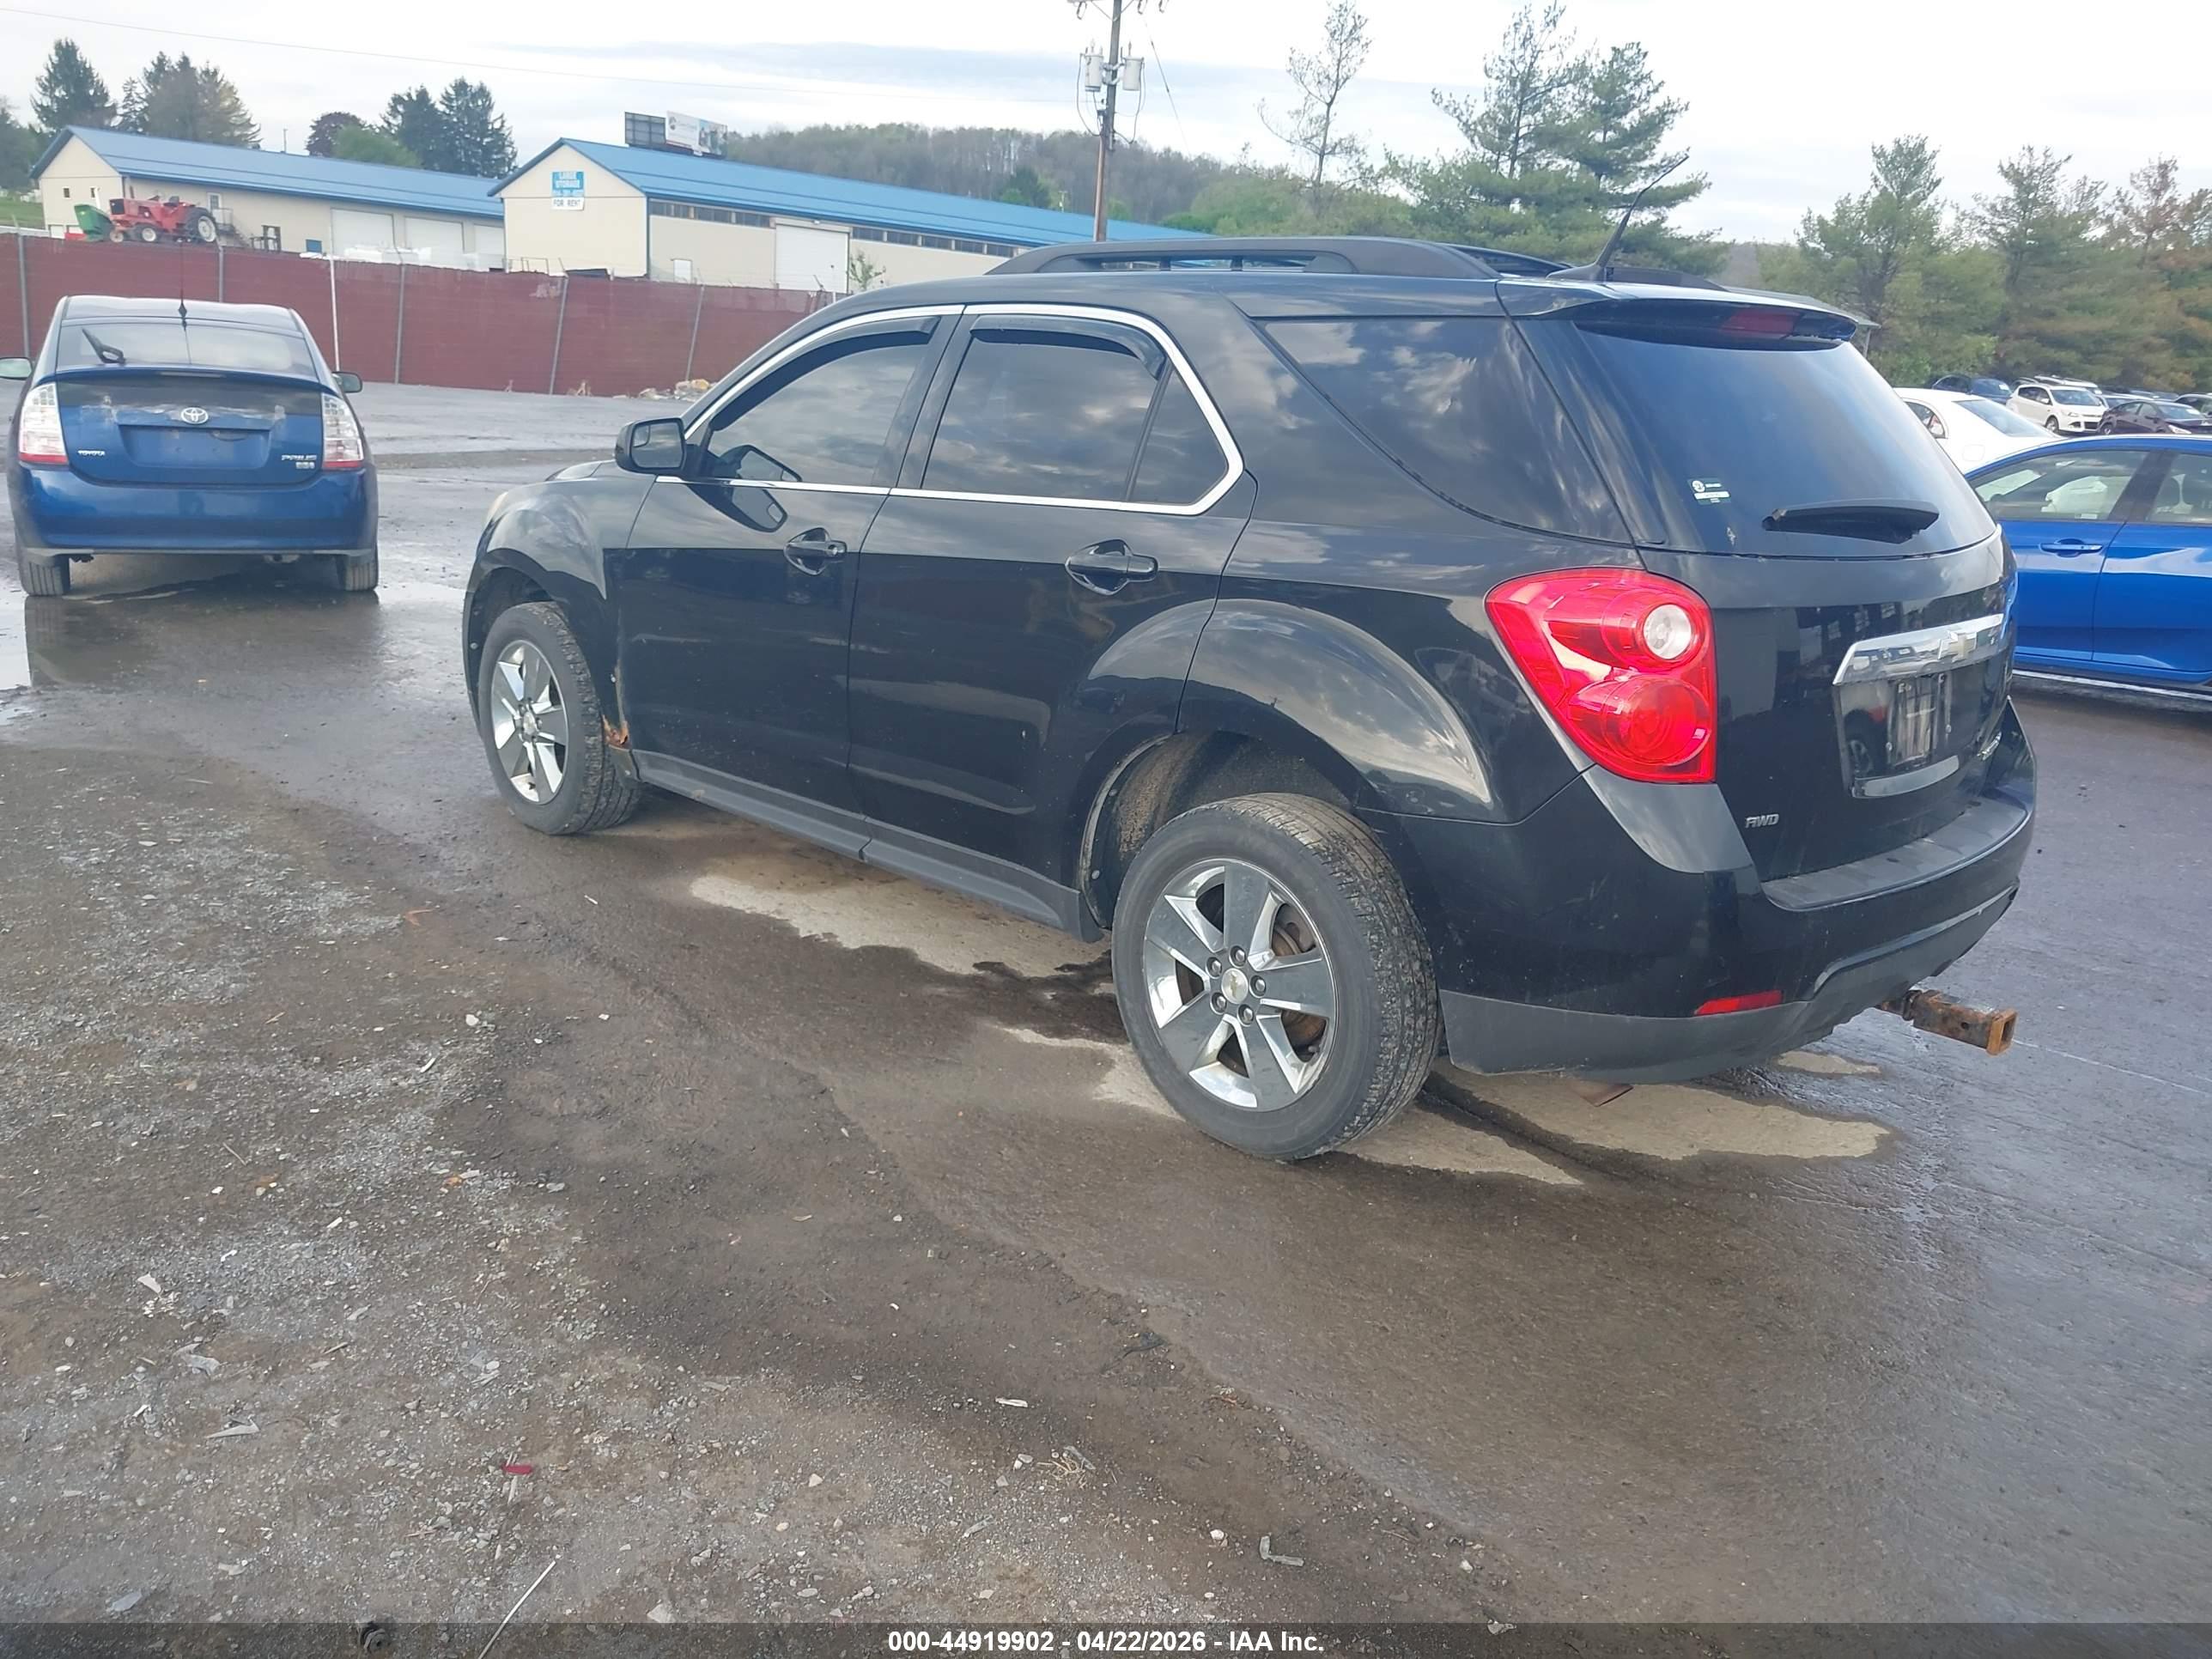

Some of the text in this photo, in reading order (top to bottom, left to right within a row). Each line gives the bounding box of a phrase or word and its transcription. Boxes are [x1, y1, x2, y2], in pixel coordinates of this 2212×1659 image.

[553, 198, 580, 207] FOR RENT
[1745, 813, 1779, 829] AWD
